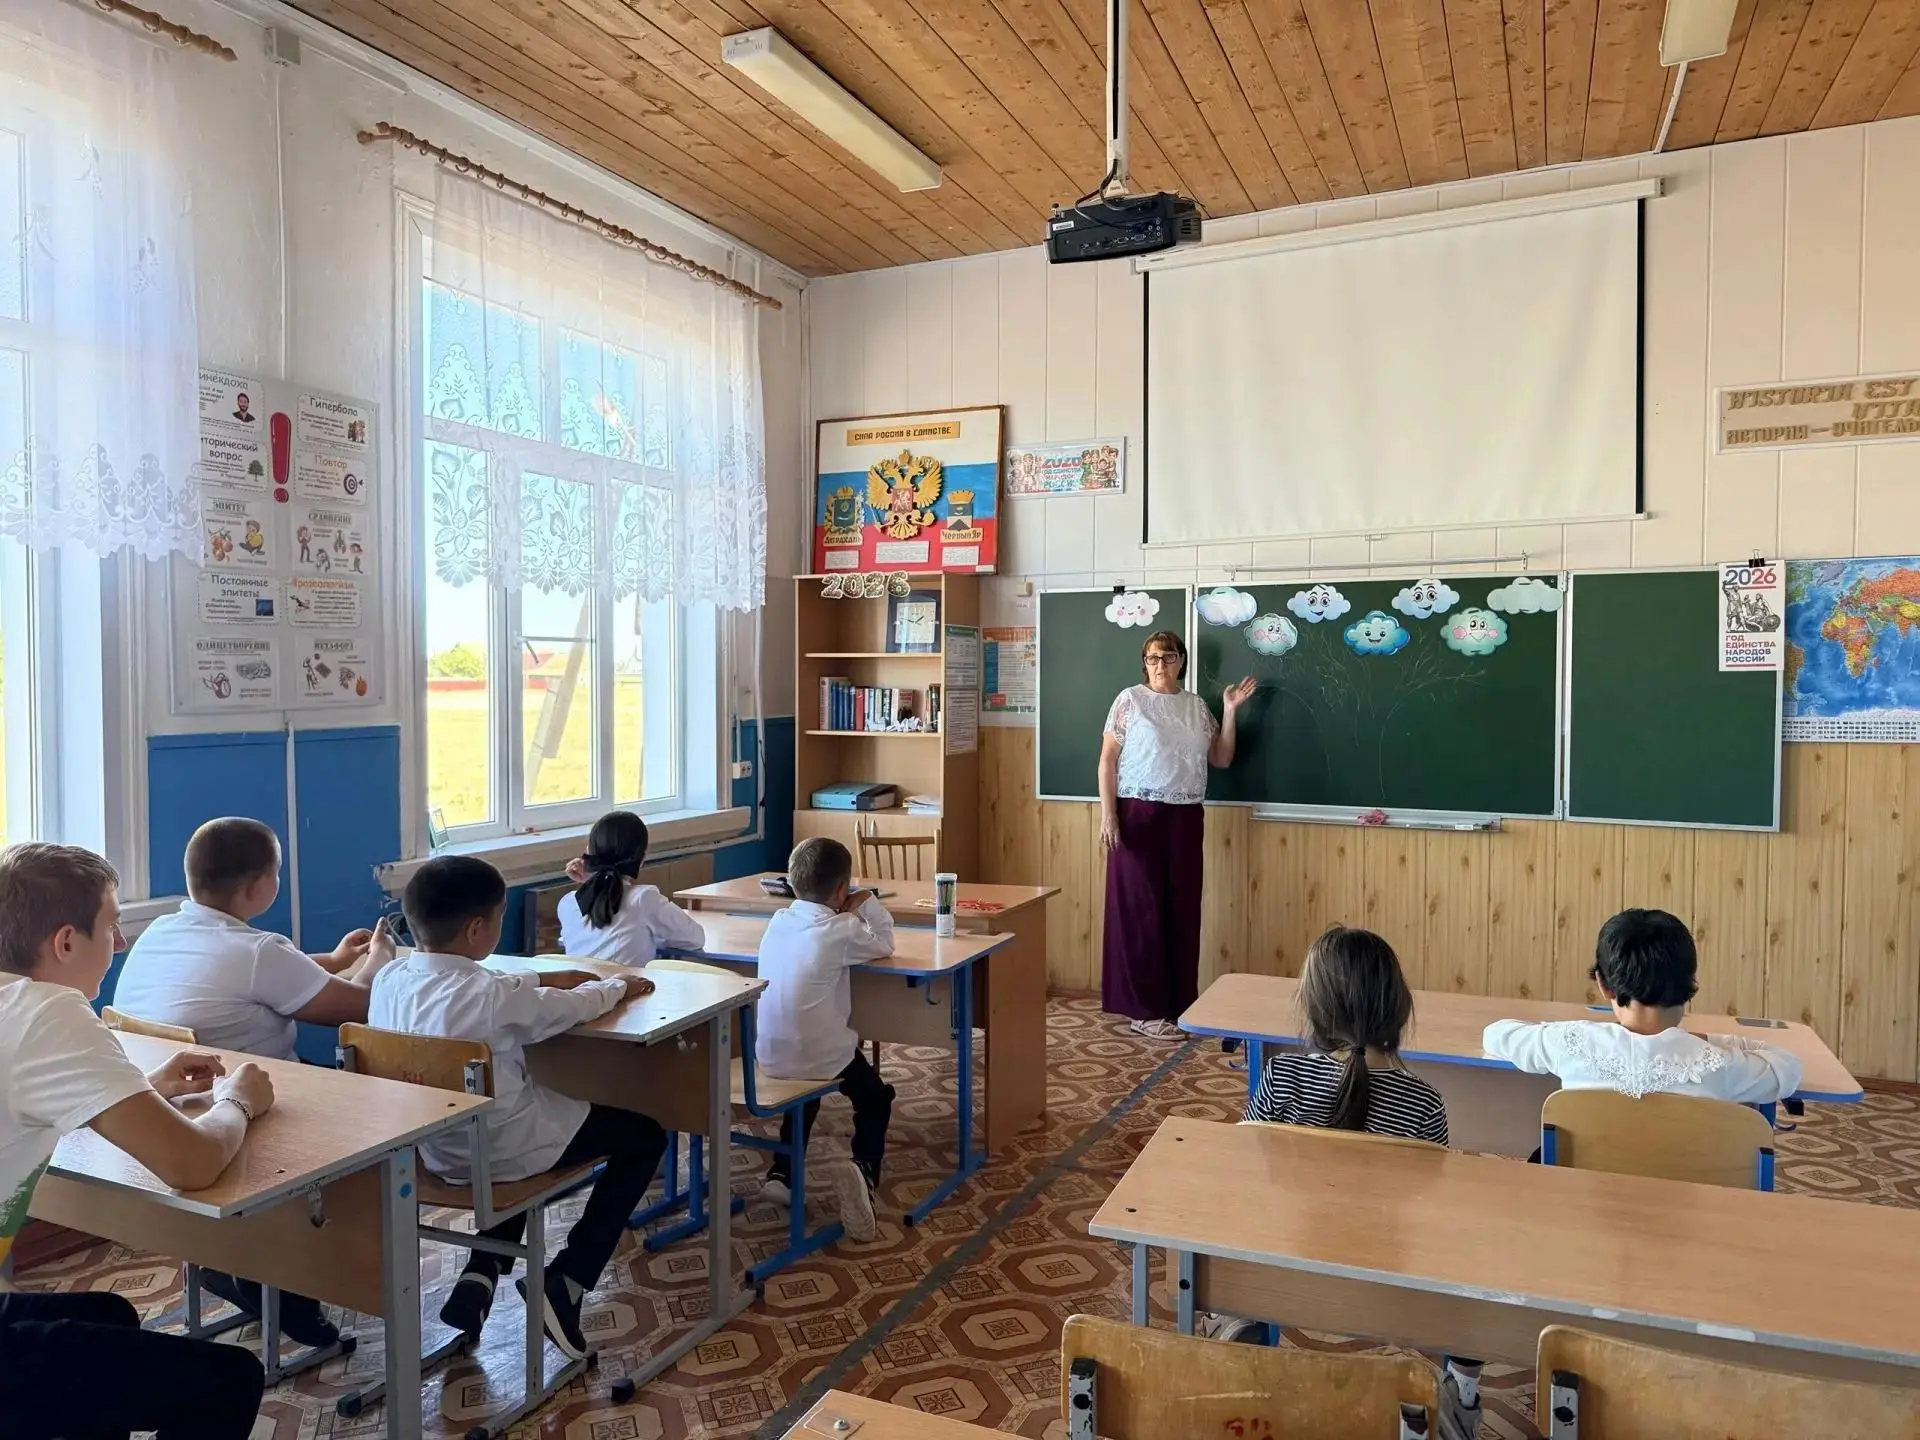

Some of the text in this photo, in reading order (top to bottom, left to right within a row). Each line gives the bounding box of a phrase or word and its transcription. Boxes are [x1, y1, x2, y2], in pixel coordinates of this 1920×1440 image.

[199, 372, 249, 391] инекдоха
[1864, 379, 1917, 399] EST
[310, 397, 359, 417] Гипербола
[1851, 398, 1920, 420] VITA
[854, 426, 952, 441] СИЛА РОССИИ В ЕДИНСТВЕ
[1726, 424, 1808, 445] ИСТОРИЯ
[1831, 418, 1920, 437] УЧИТЕЛЬ
[200, 436, 258, 453] торический
[209, 449, 243, 463] вопрос
[315, 454, 347, 473] Повтор
[211, 574, 270, 588] Постоянные
[821, 570, 911, 599] 2026
[1725, 567, 1777, 586] 2026
[220, 588, 260, 599] эпитеты
[1725, 641, 1777, 649] ЕДИНСТВА
[1725, 648, 1772, 656] НАРОДОВ
